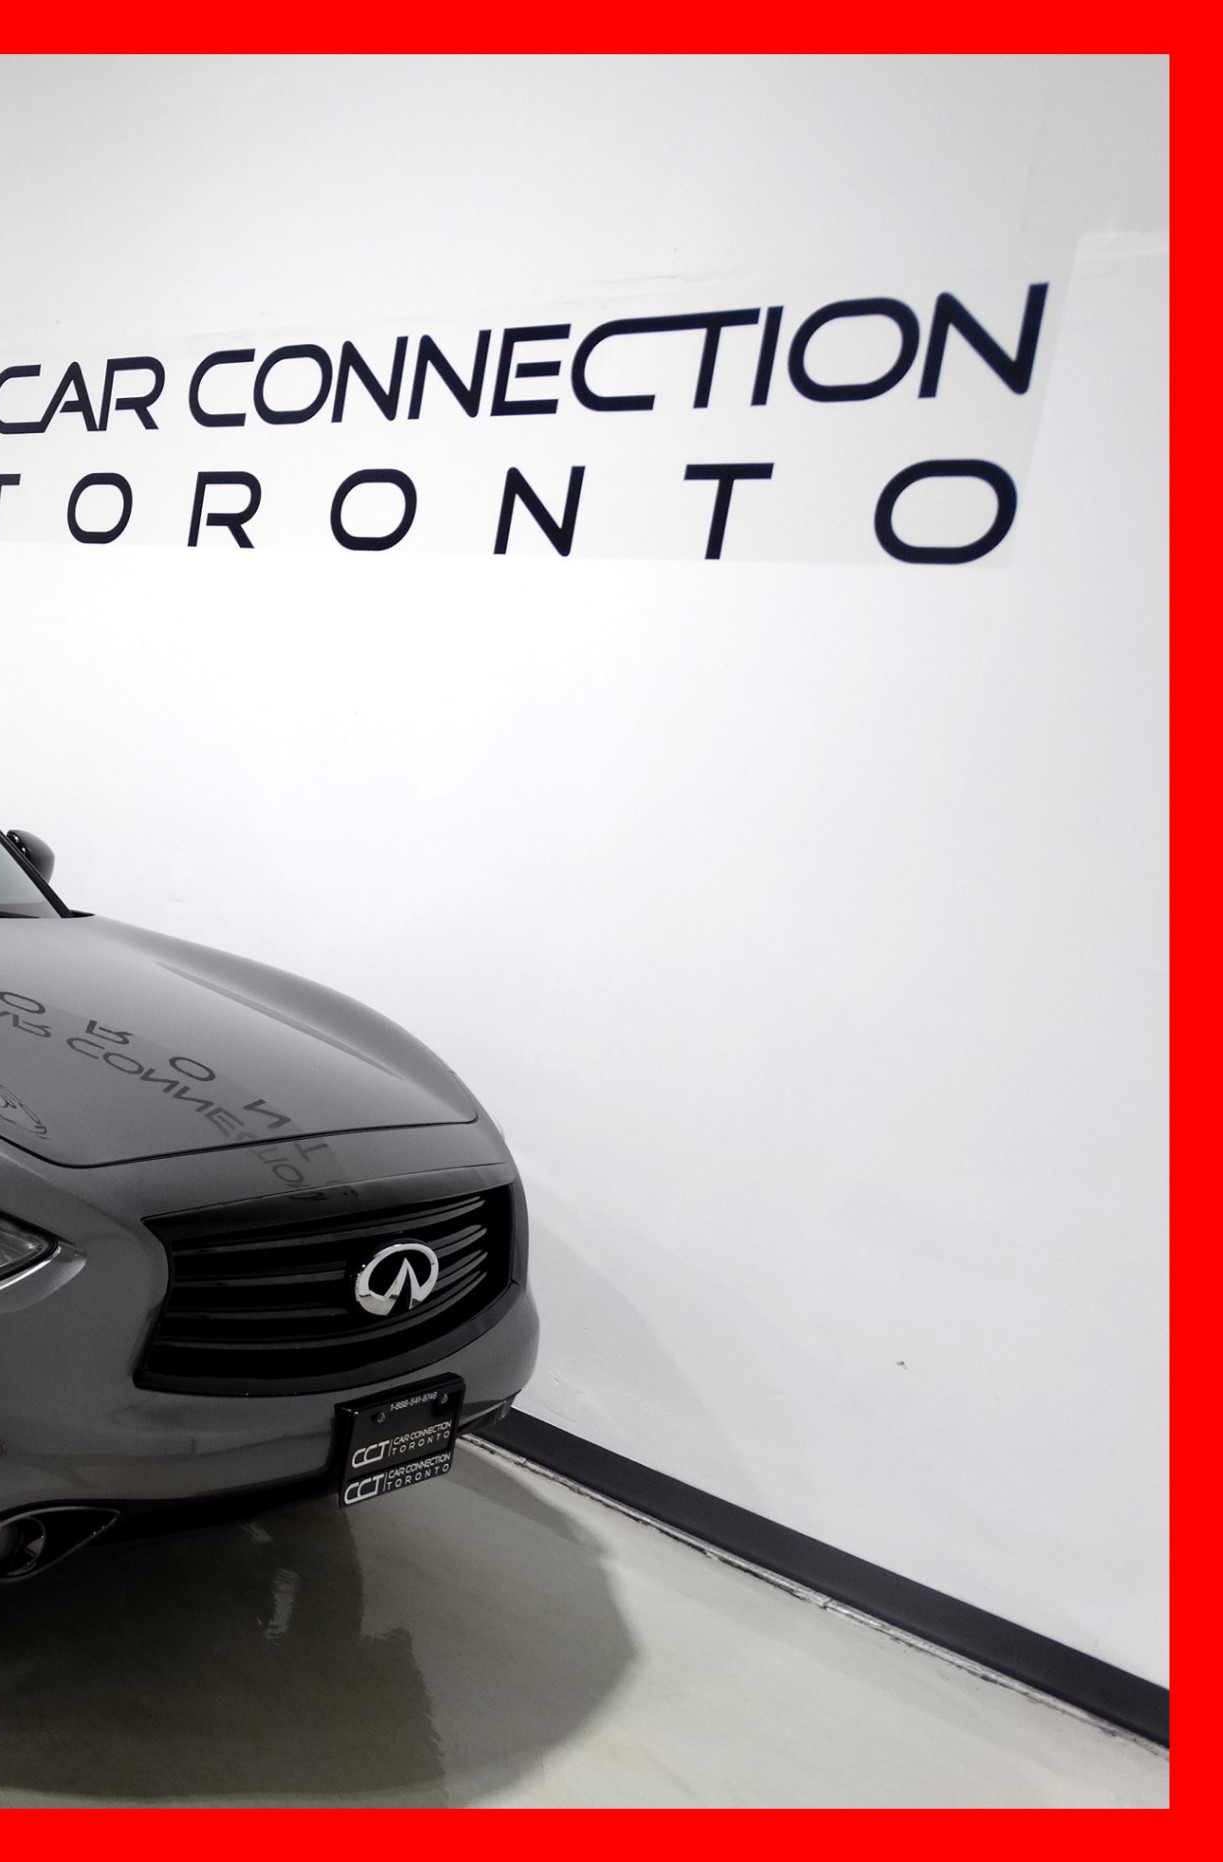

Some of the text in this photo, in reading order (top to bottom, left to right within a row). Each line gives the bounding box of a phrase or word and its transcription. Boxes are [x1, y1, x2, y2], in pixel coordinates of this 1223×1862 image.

[188, 283, 1049, 428] CONNECTION
[392, 1430, 450, 1456] TORONTO
[393, 1420, 452, 1446] CAR CONNECTION
[351, 1439, 390, 1469] CCT
[388, 1453, 451, 1480] CAR CONNECTION
[344, 1473, 385, 1505] CCT
[386, 1463, 450, 1491] TORONTO
